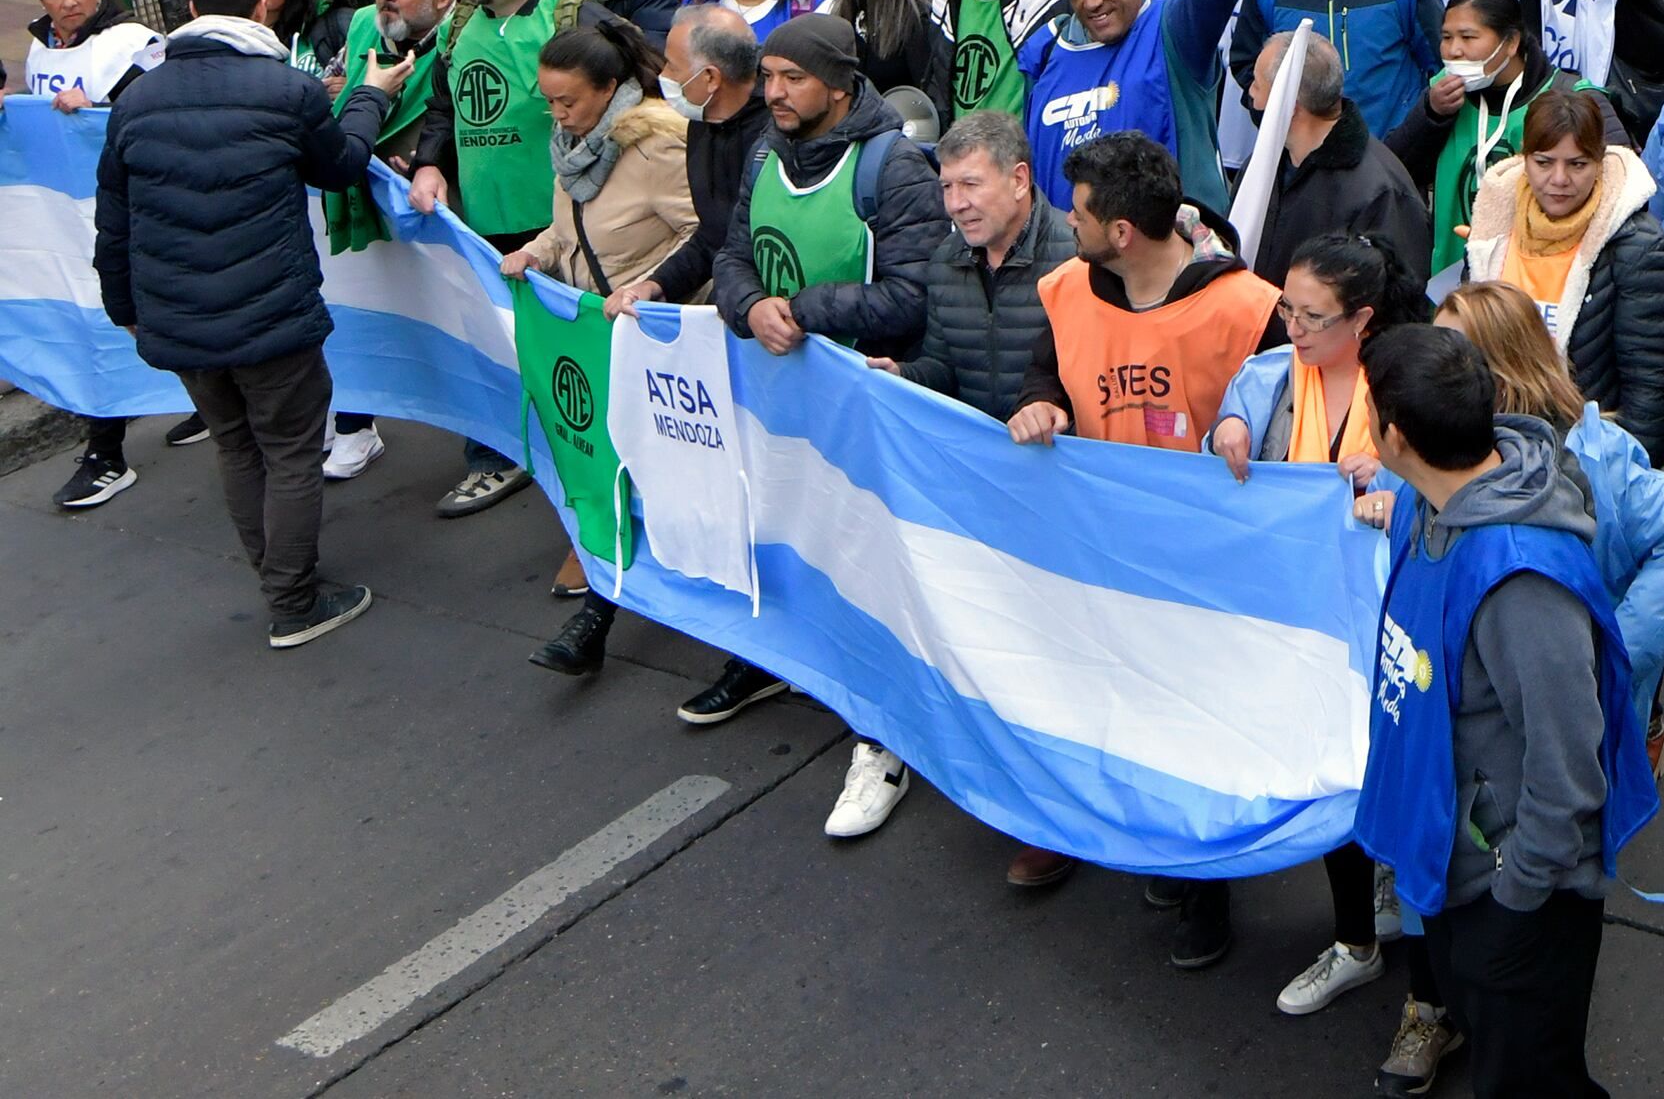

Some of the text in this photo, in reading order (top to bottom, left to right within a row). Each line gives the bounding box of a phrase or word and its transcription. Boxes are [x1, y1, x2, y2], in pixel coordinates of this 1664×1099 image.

[458, 64, 504, 122] ATE
[557, 364, 592, 426] ATE
[645, 368, 718, 419] ATSA
[653, 413, 726, 452] MENDOZA
